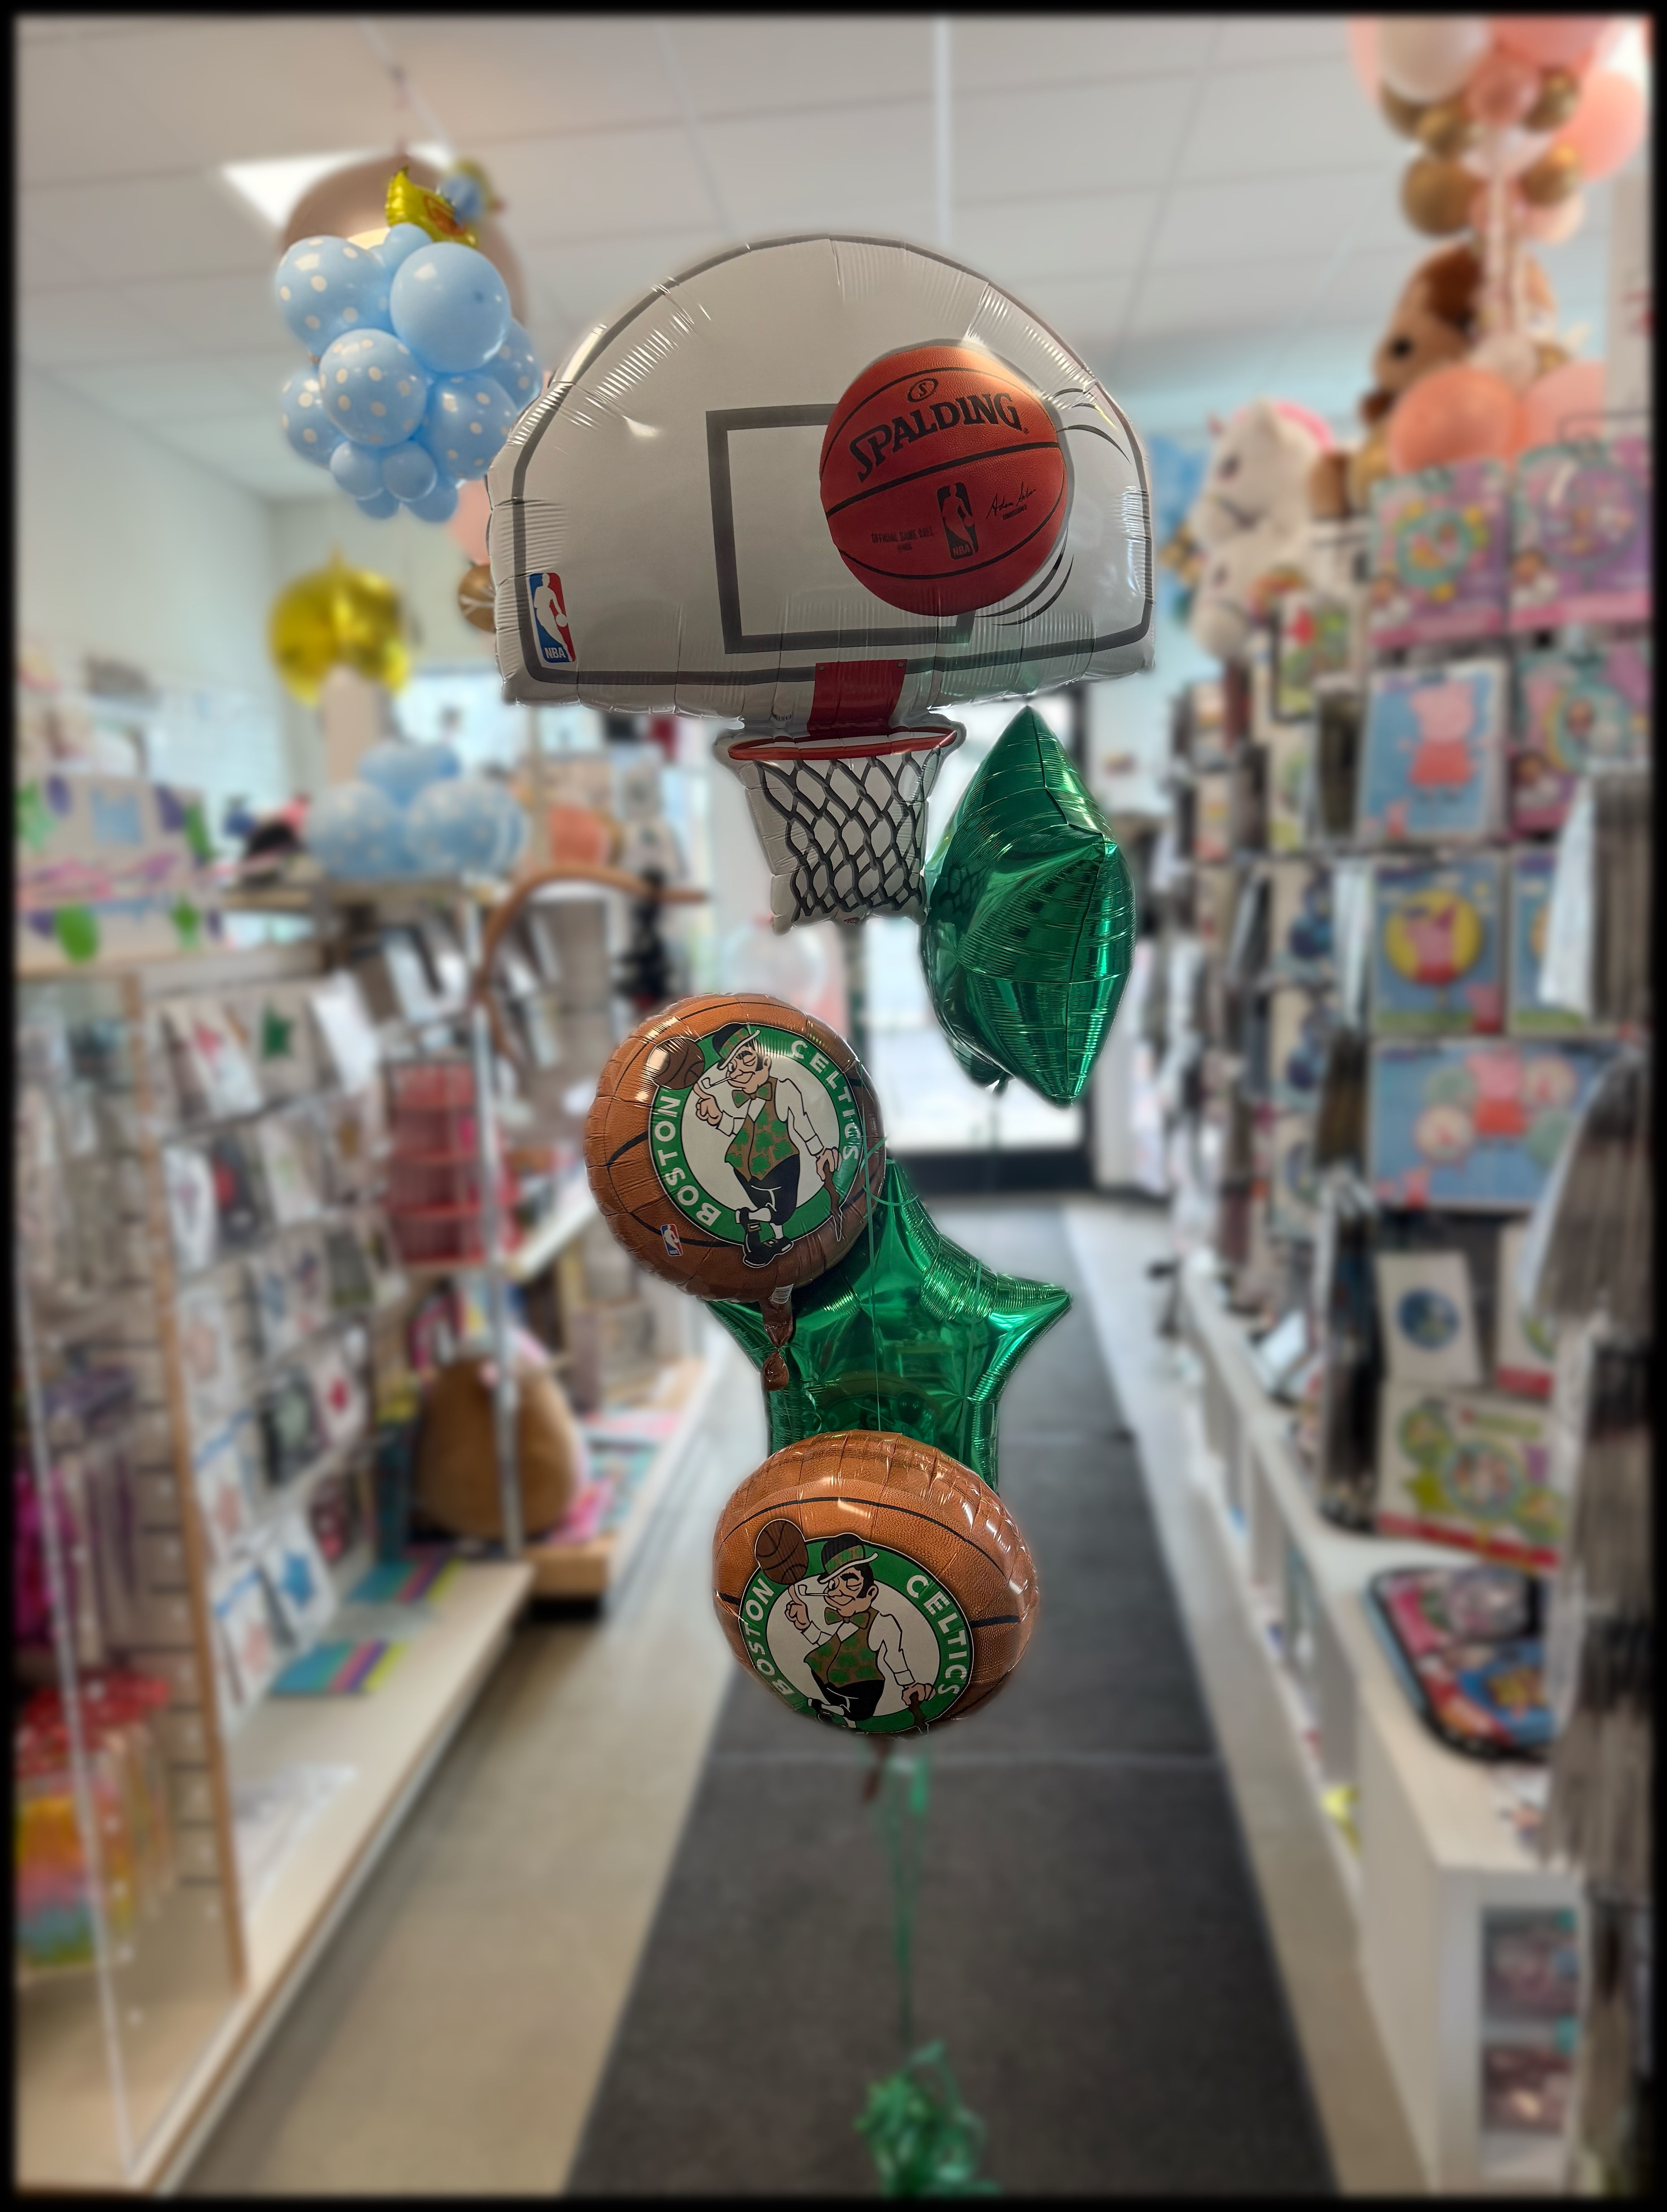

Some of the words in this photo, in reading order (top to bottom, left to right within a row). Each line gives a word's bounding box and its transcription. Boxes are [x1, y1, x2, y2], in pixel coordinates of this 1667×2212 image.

[849, 392, 1021, 483] SPALDING
[953, 544, 971, 556] NBA
[545, 647, 566, 658] NBA
[791, 1040, 862, 1161] CELTICS
[655, 1095, 722, 1227] BOSTON
[744, 1578, 790, 1695] BOSTON
[907, 1575, 967, 1695] CELTICS
